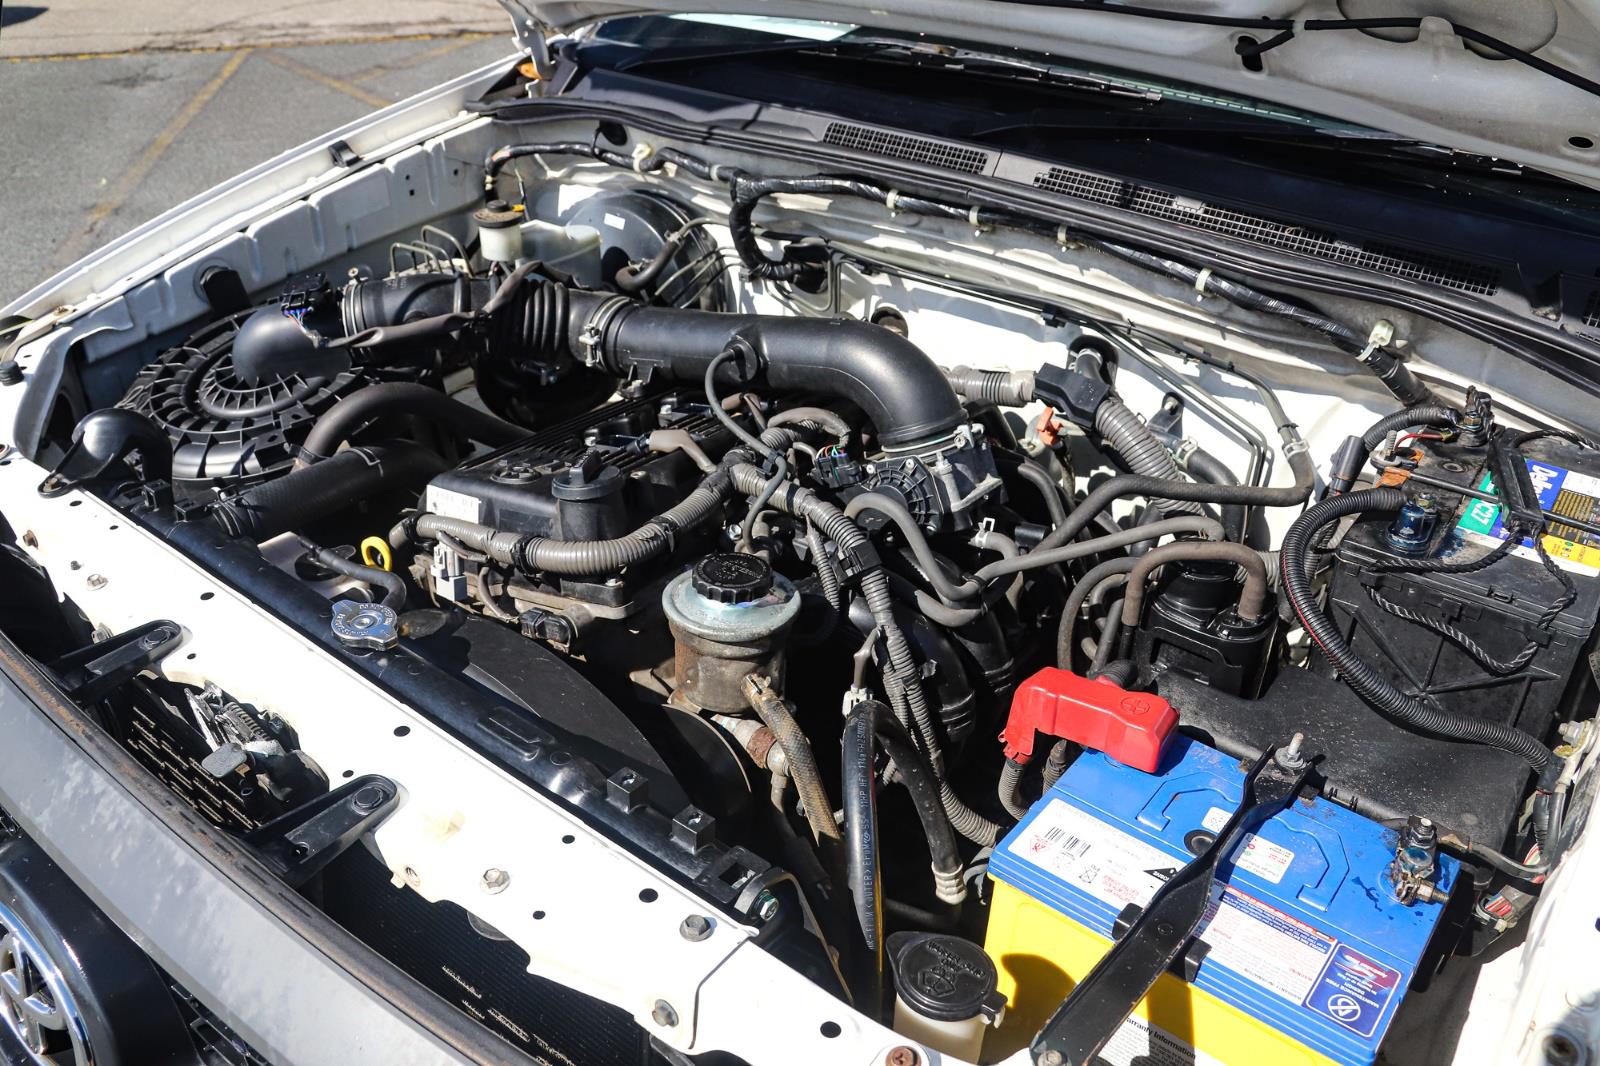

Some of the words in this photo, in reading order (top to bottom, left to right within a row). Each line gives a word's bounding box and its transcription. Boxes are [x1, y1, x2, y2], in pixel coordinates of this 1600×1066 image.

[1338, 984, 1381, 1008] MAINTENANCE
[1126, 1017, 1153, 1036] arranty
[1153, 1031, 1196, 1060] Information
